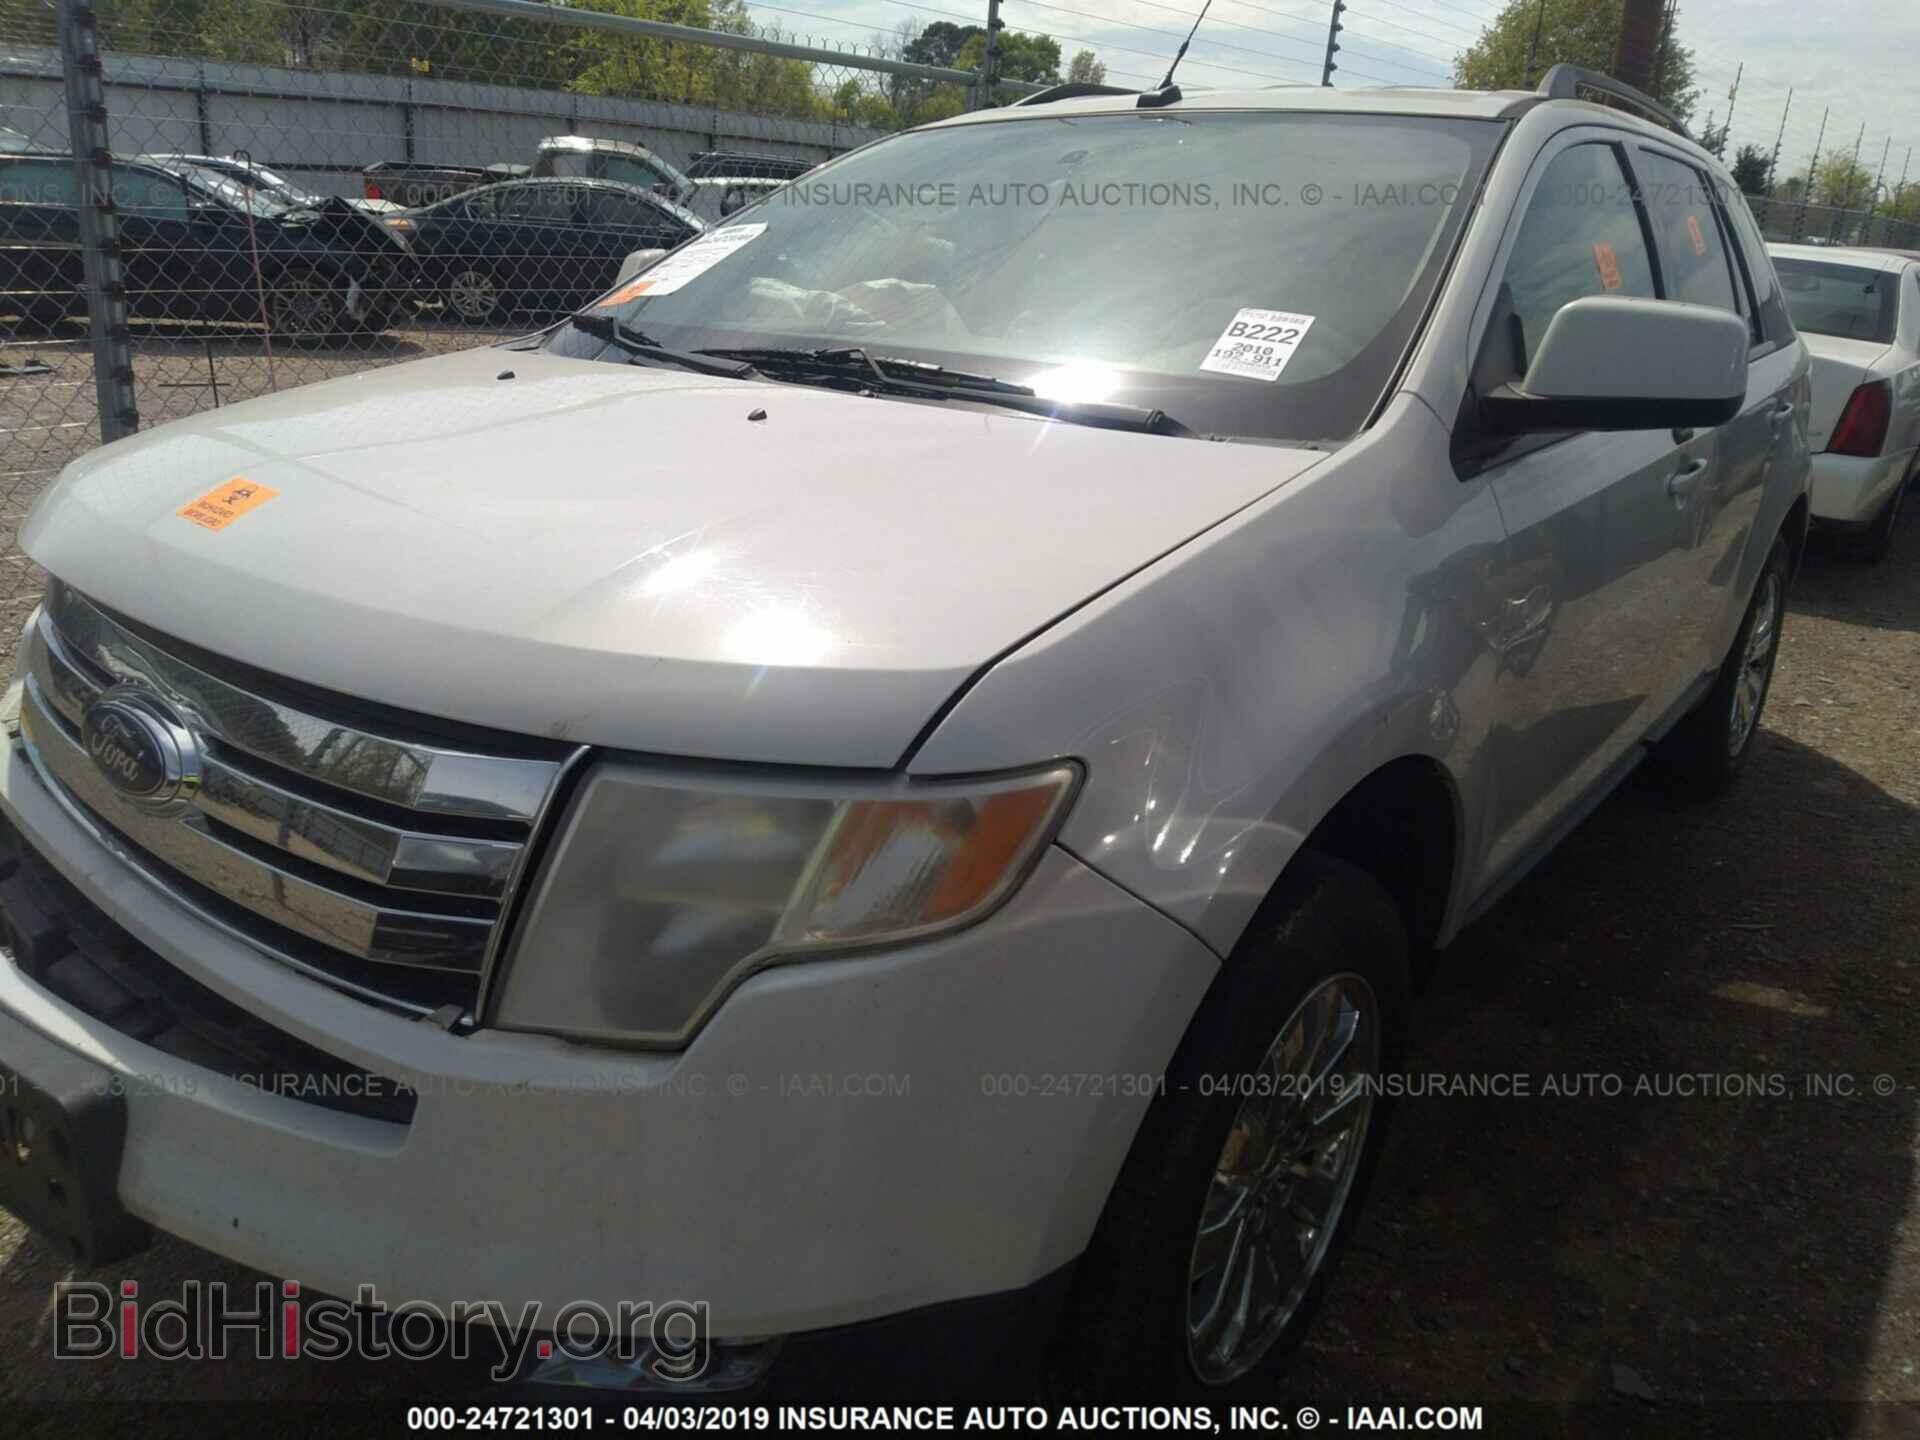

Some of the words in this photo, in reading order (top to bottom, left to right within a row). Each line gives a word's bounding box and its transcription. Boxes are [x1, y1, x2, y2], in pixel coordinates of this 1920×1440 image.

[1228, 321, 1300, 345] B222
[1232, 342, 1274, 356] 2010
[91, 713, 138, 781] Ford
